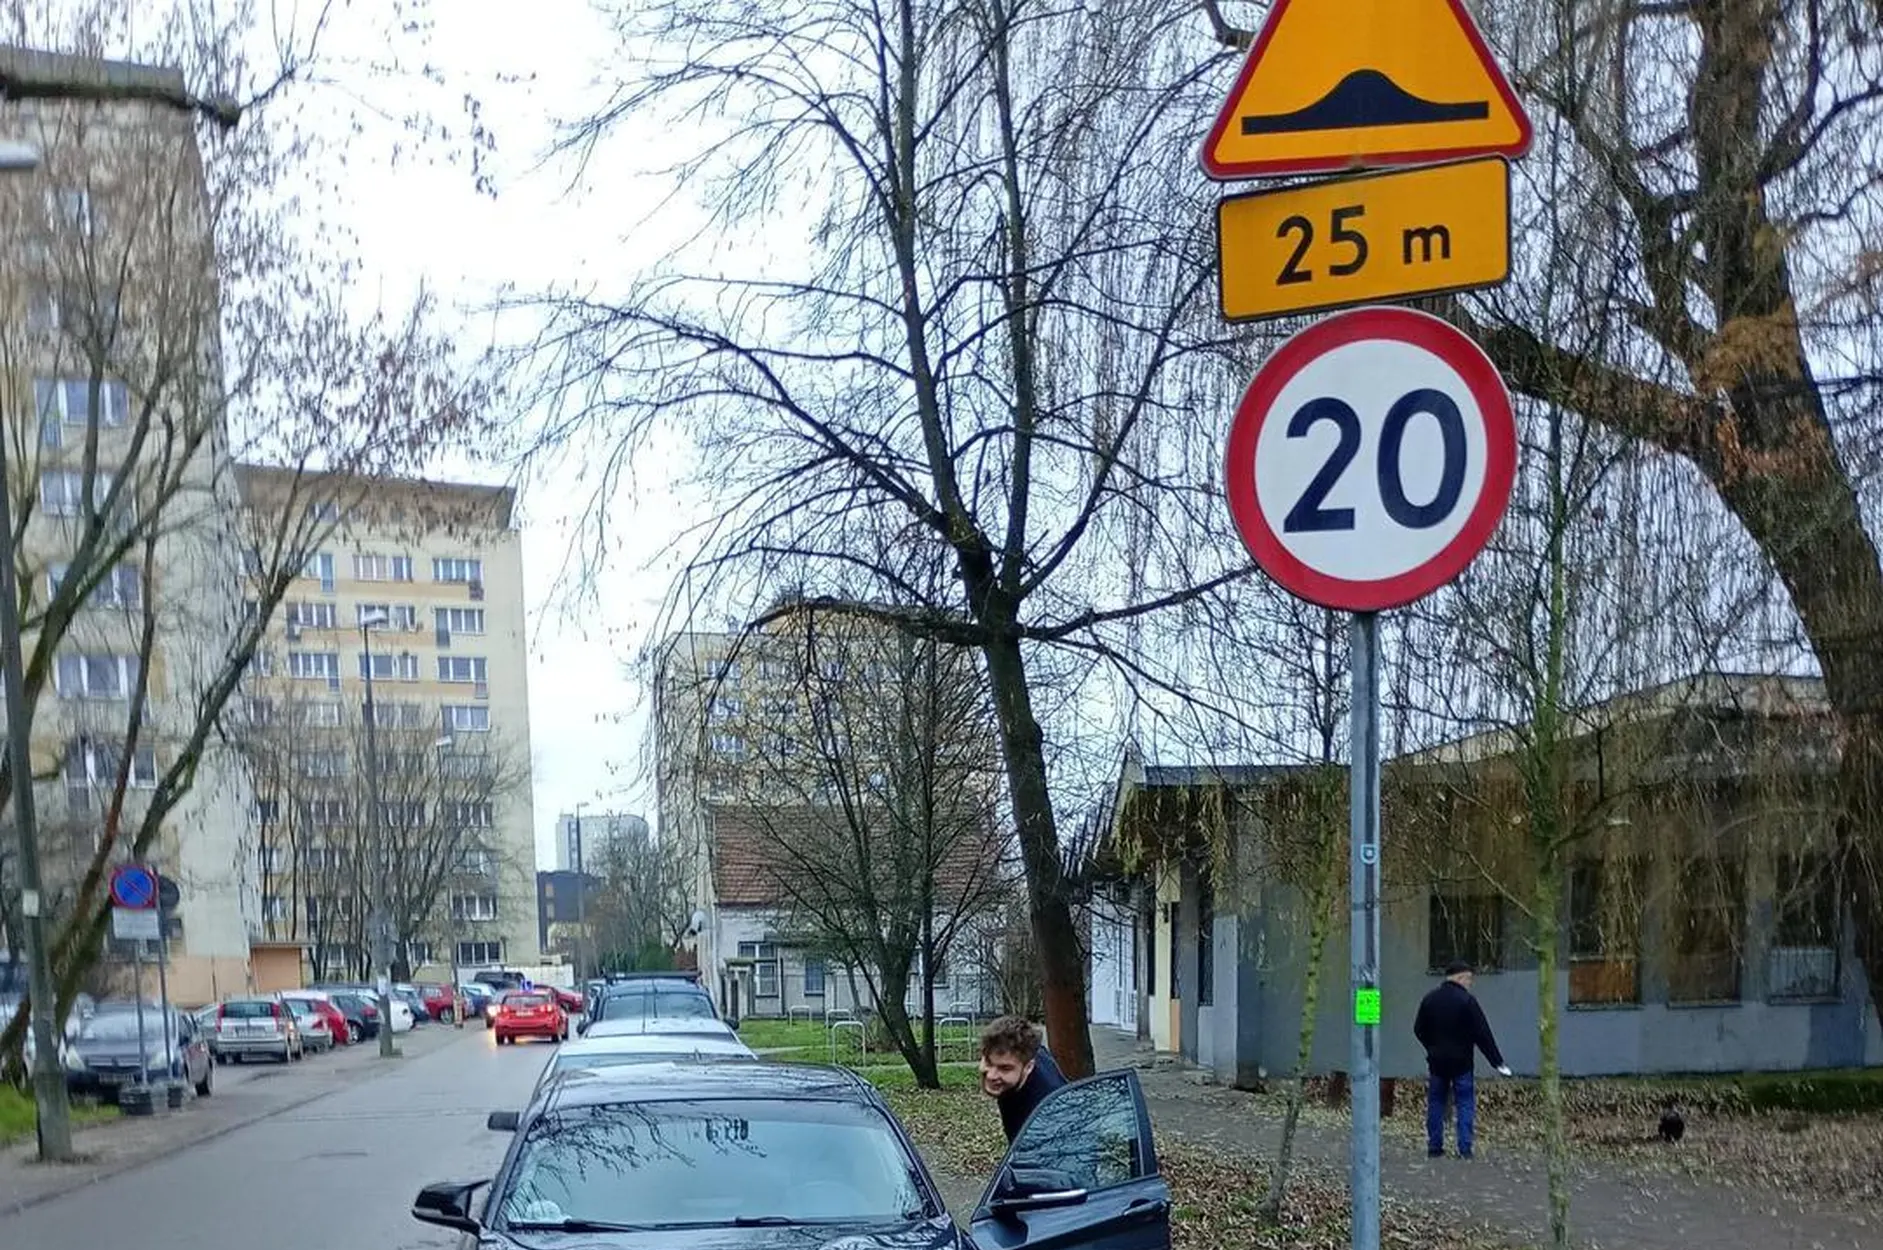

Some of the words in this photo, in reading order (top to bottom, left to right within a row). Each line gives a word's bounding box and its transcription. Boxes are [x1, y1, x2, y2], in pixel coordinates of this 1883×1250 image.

[1276, 205, 1368, 285] 25
[1403, 225, 1450, 264] m
[1283, 388, 1467, 533] 20
